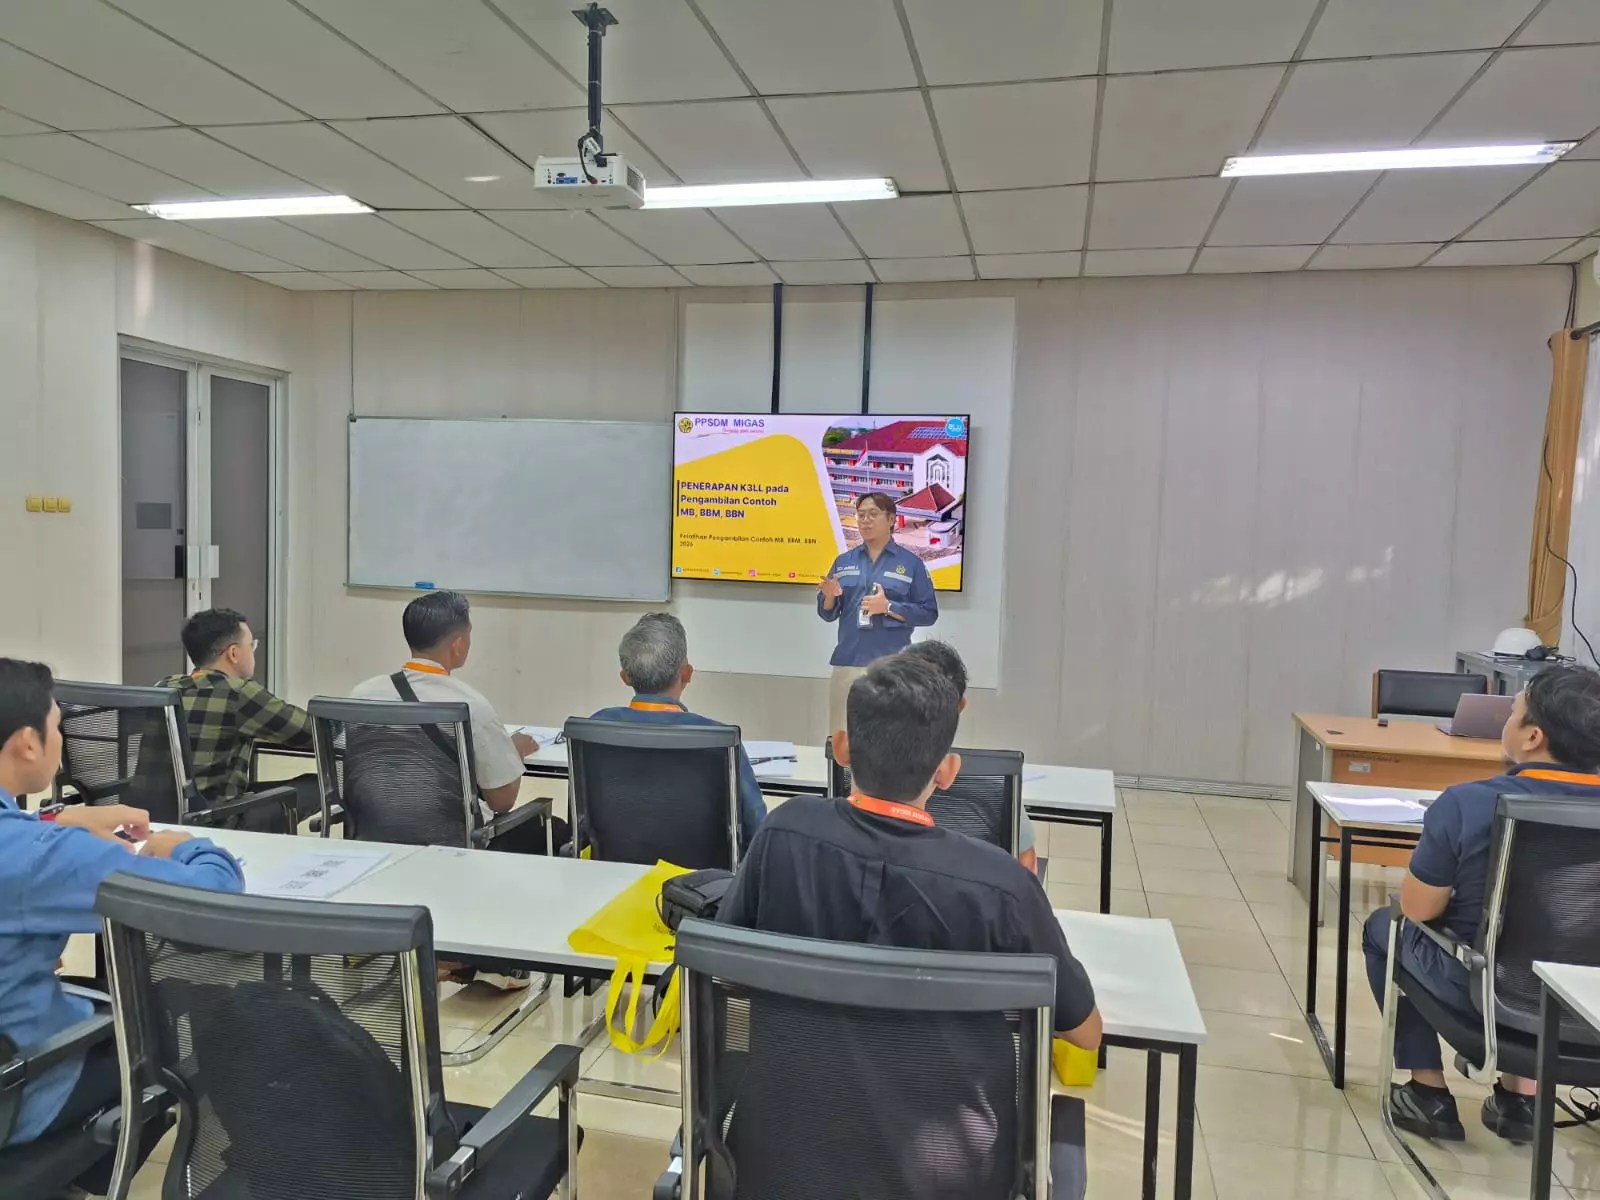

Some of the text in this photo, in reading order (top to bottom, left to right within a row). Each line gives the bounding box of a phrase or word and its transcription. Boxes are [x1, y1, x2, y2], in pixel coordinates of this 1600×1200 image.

[695, 417, 765, 428] PPSDM MIGAS
[681, 482, 789, 494] PENERAPAN K3LL pada
[680, 495, 777, 506] Pengambilan Contoh
[700, 509, 722, 518] BBM,
[725, 510, 745, 518] BBN
